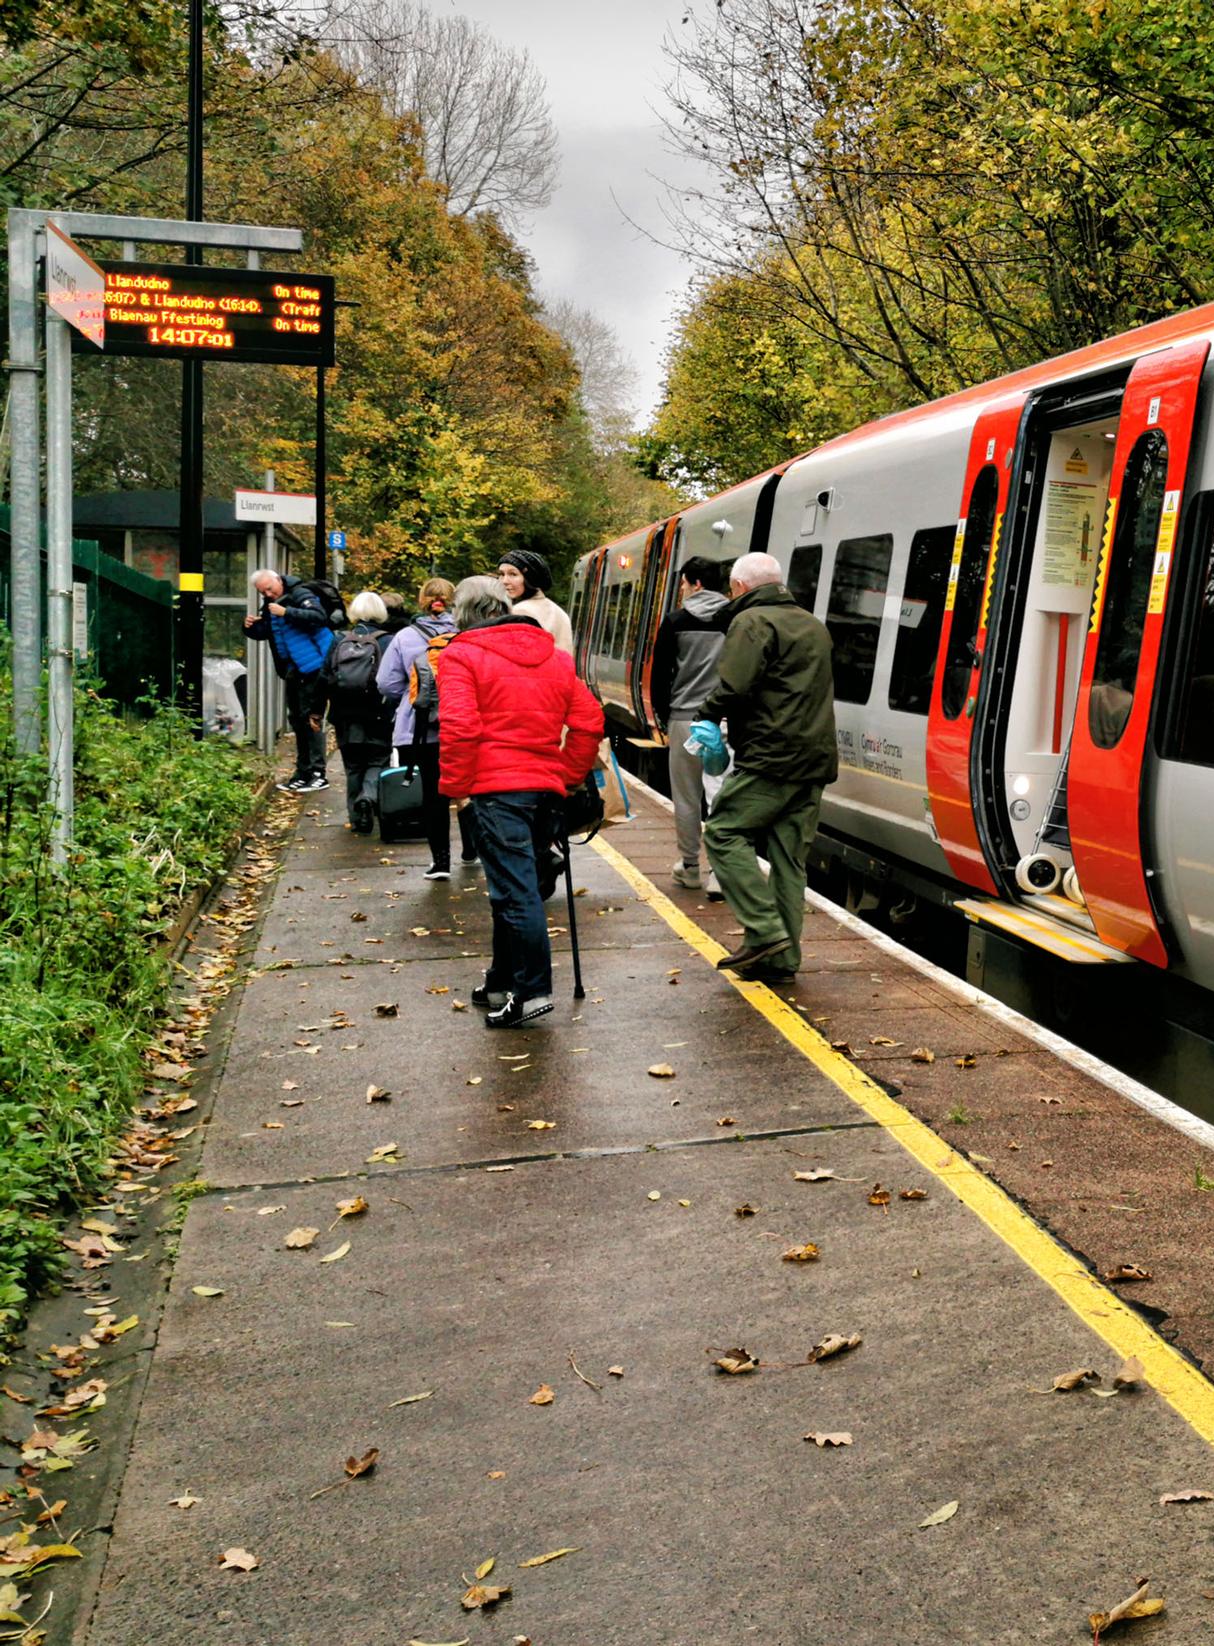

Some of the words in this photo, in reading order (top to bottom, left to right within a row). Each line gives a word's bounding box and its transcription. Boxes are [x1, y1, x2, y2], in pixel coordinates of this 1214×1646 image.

[107, 274, 171, 290] Llandudno
[274, 285, 291, 299] On
[294, 286, 320, 301] time
[140, 294, 151, 307] &
[154, 293, 216, 311] Llandudno
[109, 308, 158, 323] Blaenau
[161, 310, 225, 329] Ffestiniog
[274, 318, 291, 332] On
[294, 320, 320, 333] time
[149, 327, 233, 348] 14:07:01
[241, 499, 275, 512] Llanrwst
[333, 534, 342, 545] S
